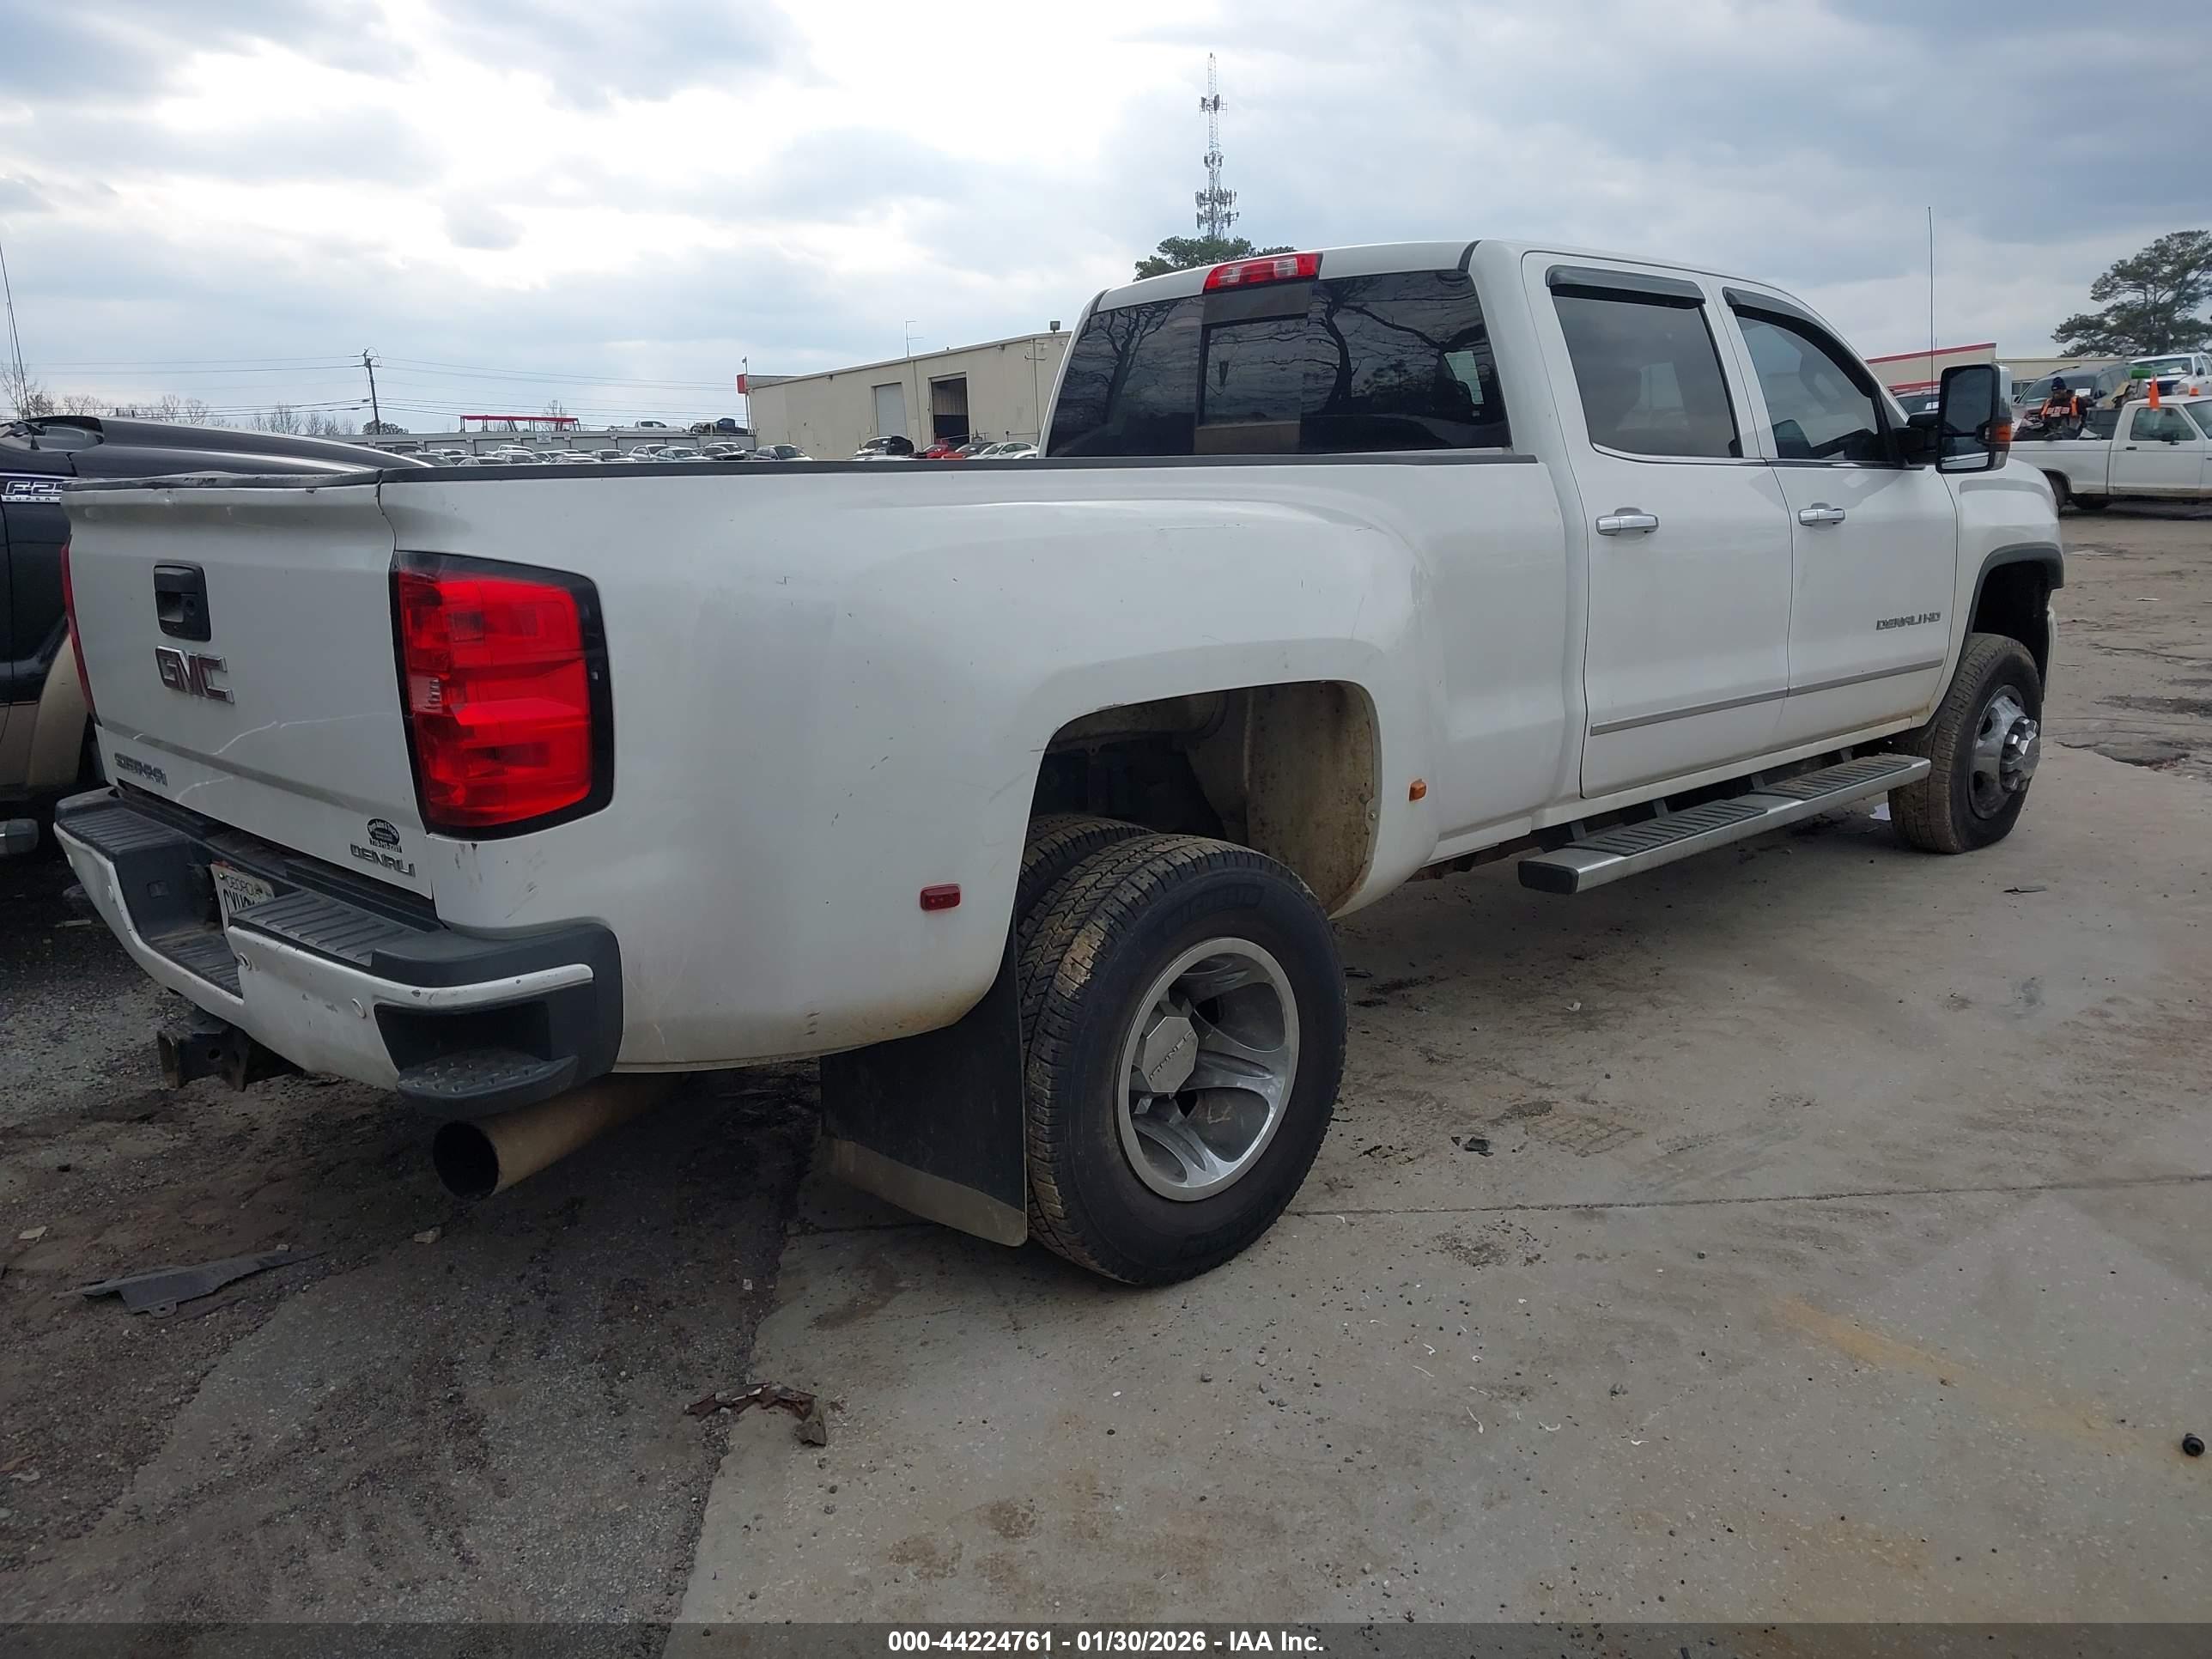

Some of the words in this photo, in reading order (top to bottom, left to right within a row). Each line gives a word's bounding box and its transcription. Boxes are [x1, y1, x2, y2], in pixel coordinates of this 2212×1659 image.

[1876, 614, 1923, 630] DENALI
[155, 645, 235, 705] GMC
[350, 843, 416, 878] DENALI
